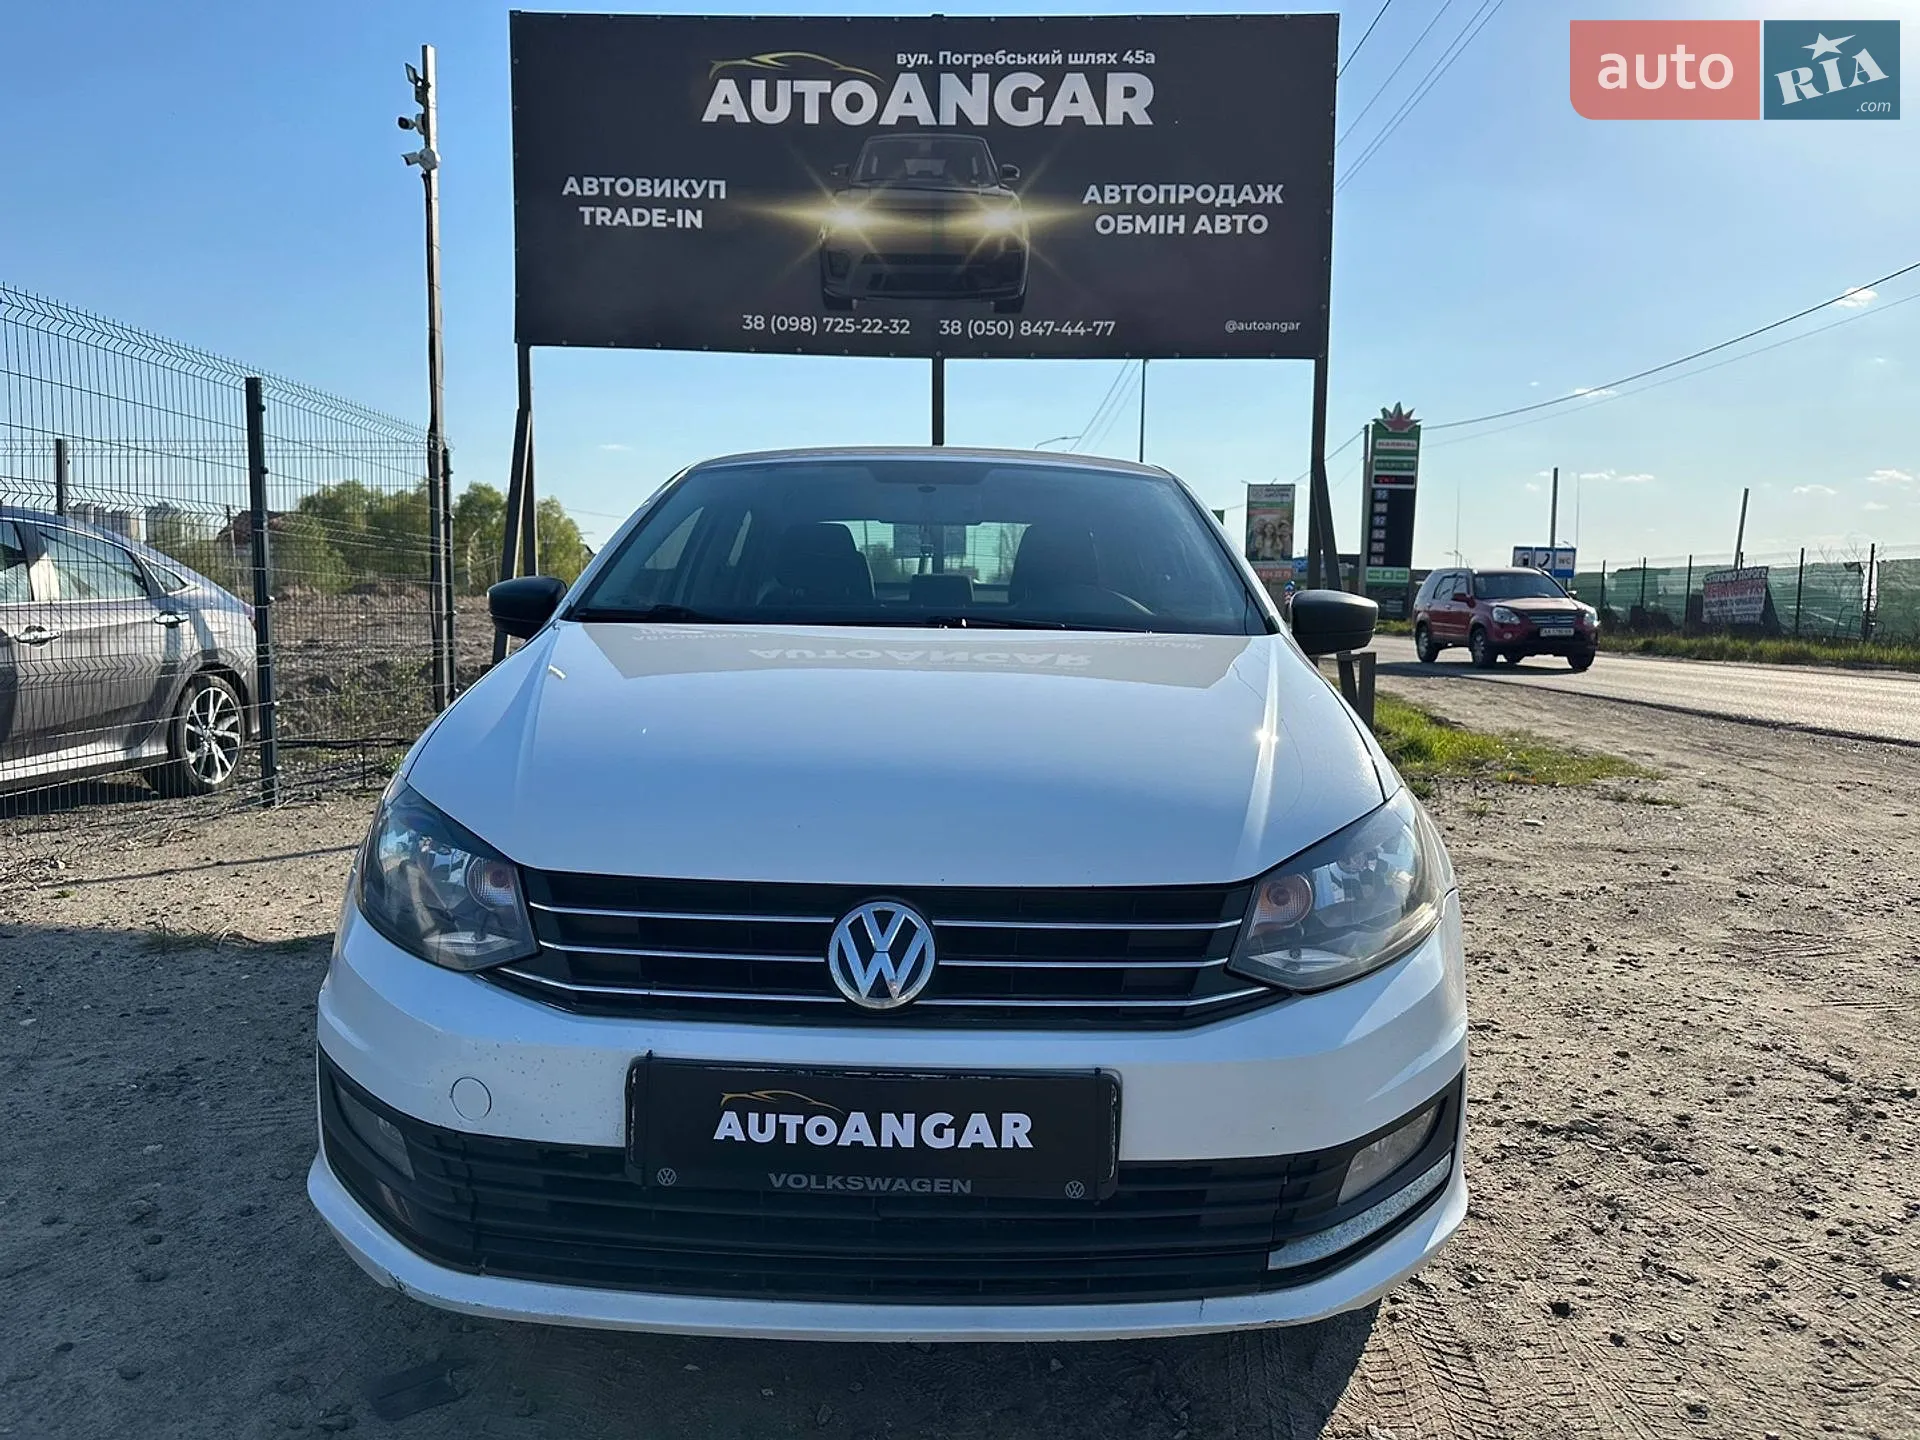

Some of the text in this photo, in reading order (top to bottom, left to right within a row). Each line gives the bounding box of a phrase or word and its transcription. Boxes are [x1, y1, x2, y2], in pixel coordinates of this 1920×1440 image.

[896, 53, 933, 68] вул.
[938, 50, 1063, 68] Погребський
[1068, 52, 1118, 66] шлях
[701, 71, 1155, 127] AUTOANGAR
[562, 176, 727, 200] АВТОВИКУП
[1082, 184, 1284, 207] АВТОПРОДАЖ
[579, 206, 704, 229] TRADE-IN
[1095, 214, 1269, 235] ОБМІН АВТО
[742, 314, 912, 336] 38 (098) 725-22-32
[939, 319, 1116, 340] 38 (050) 847-44-77
[1225, 319, 1302, 334] @autoangar
[712, 1110, 1034, 1150] AUTOANGAR
[767, 1172, 973, 1194] VOLKSWAGEN
